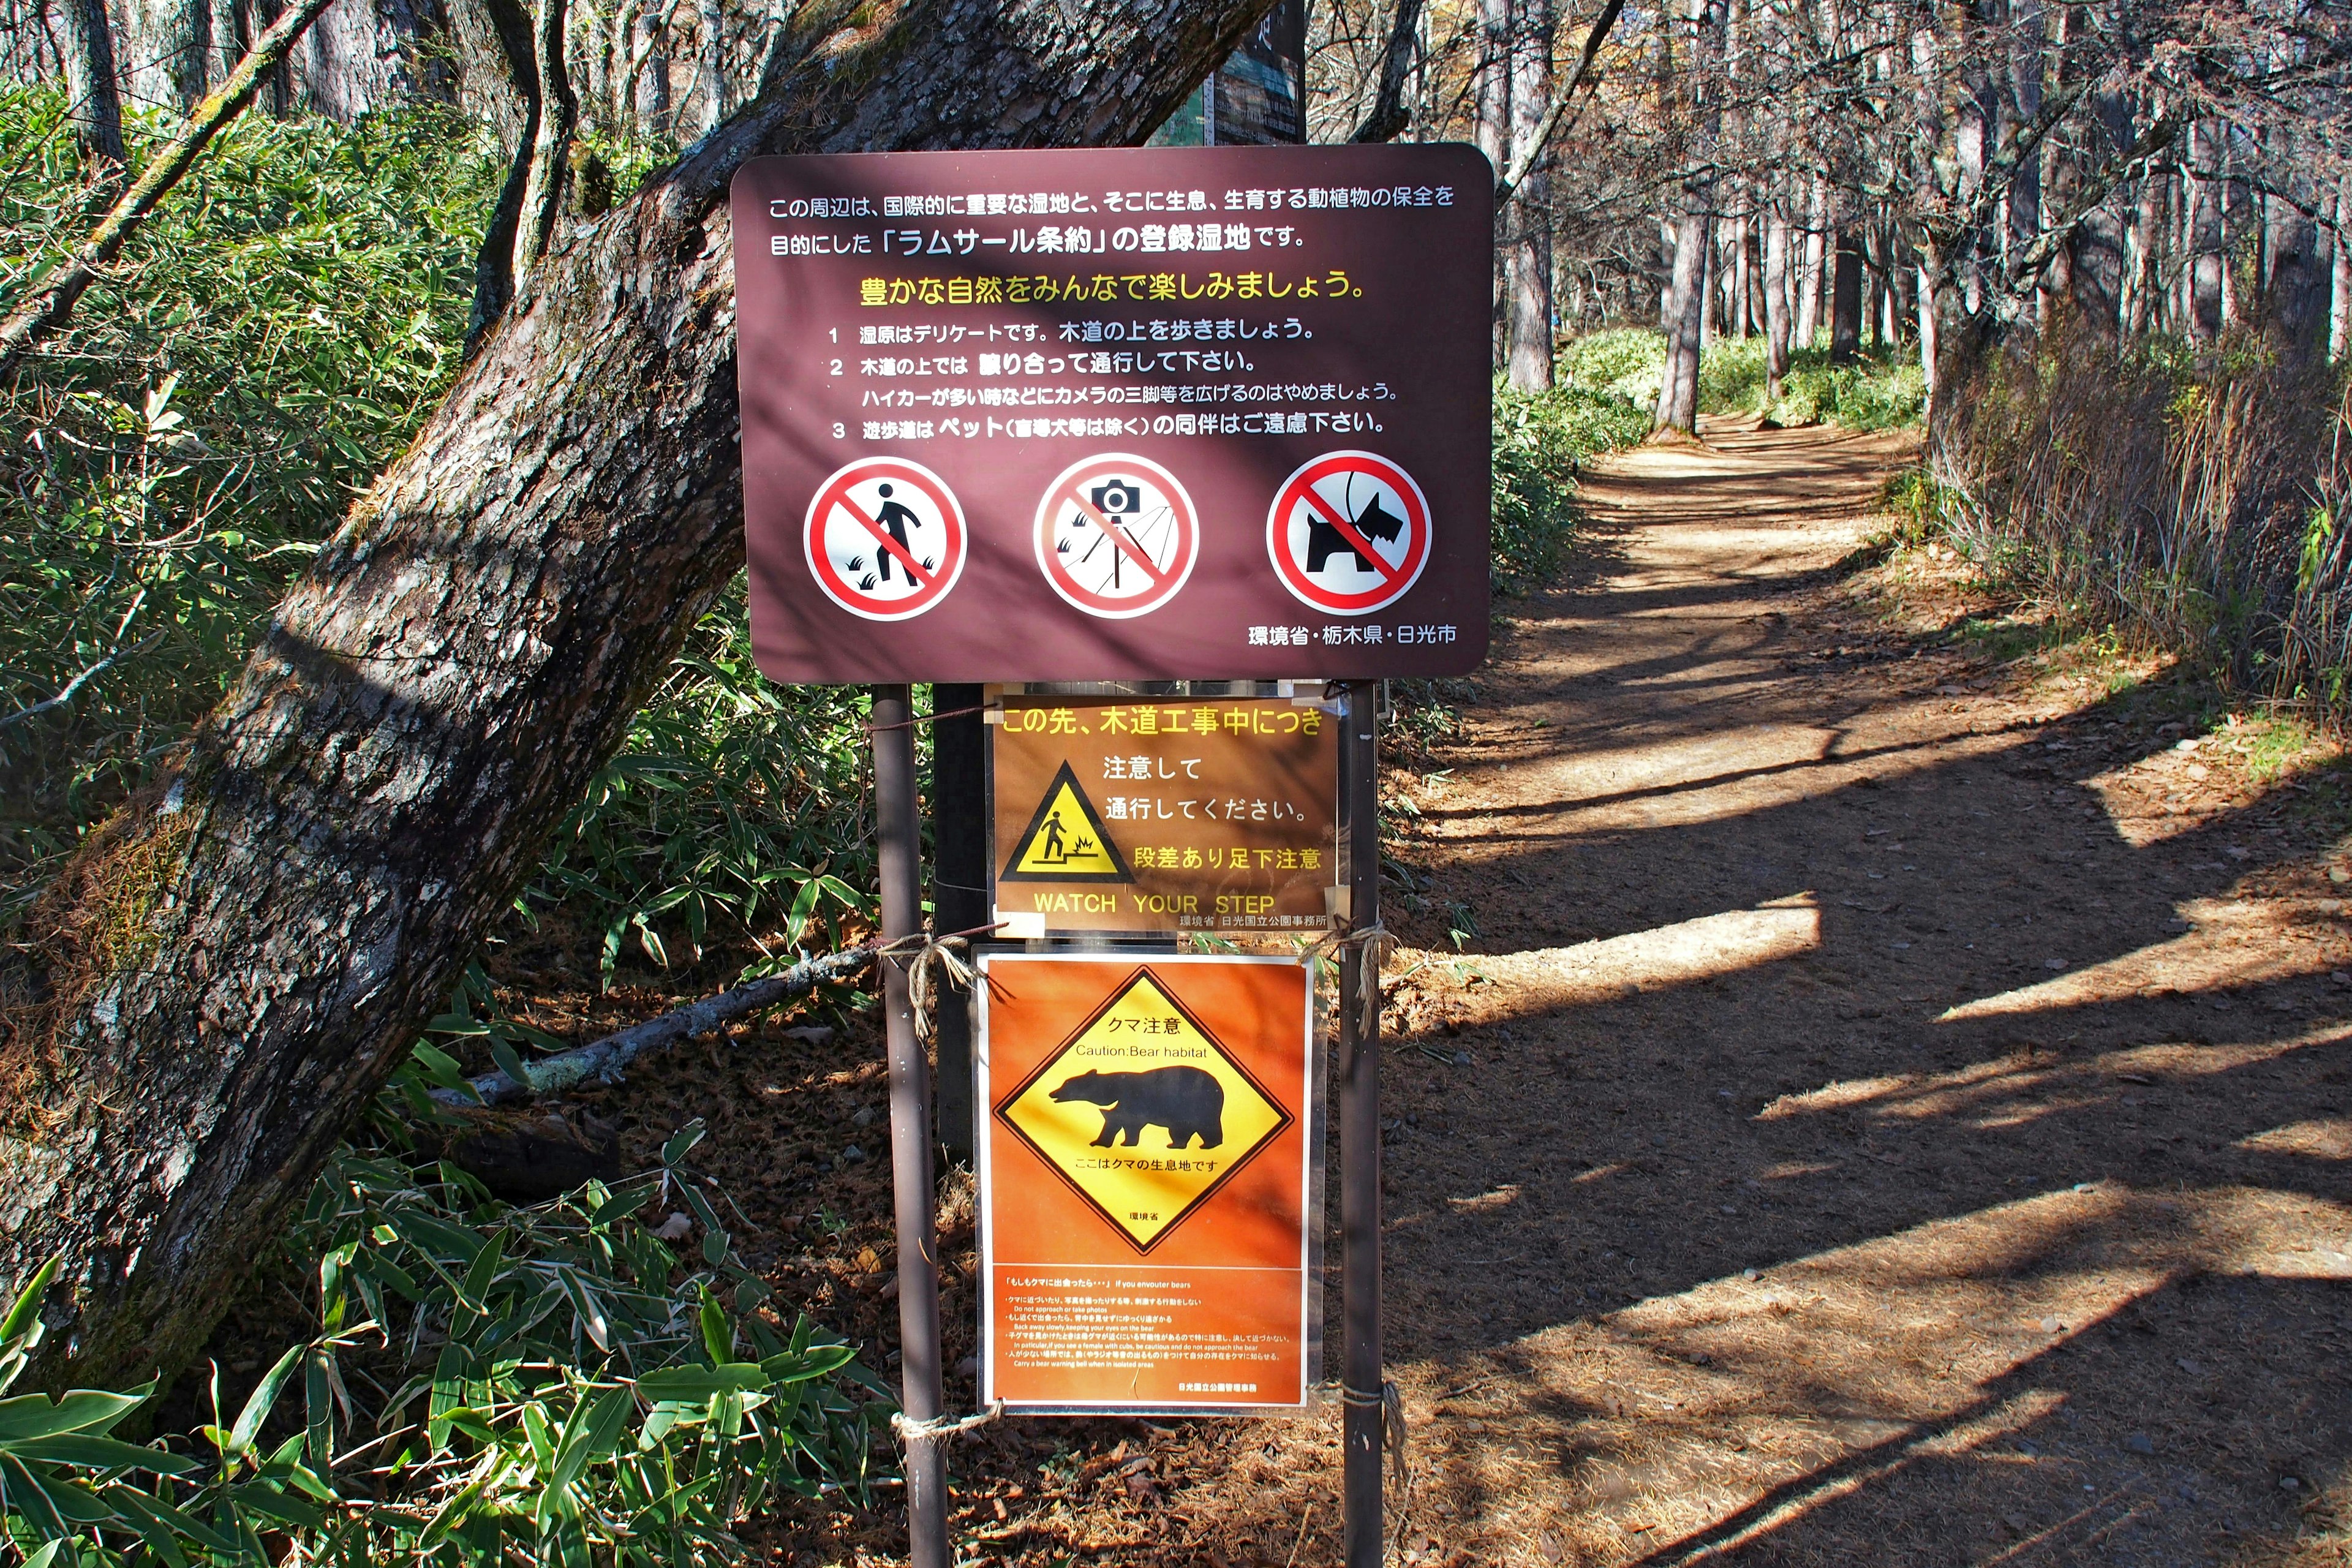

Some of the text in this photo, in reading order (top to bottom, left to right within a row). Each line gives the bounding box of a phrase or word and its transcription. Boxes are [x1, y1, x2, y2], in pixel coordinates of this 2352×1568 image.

[769, 186, 1454, 218] この周辺は、国際的に重要な湿地と、そこに生息、生育する動植物の保全を
[771, 222, 1304, 256] 目的にした「ラムサール条約」の登録湿地です。
[860, 270, 1363, 306] 豊かな自然をみんなで楽しみましょう。
[829, 326, 838, 344] 1
[829, 358, 843, 376] 2
[862, 383, 1397, 407] ハイカーが多い時などにカメラの三脚等を広げるのはやめましょう。
[832, 423, 845, 439] 3
[1248, 624, 1458, 646] 環境省・栃木県・日光市
[1003, 705, 1322, 736] この先、木道工事中につき
[1103, 755, 1202, 780] 注意して
[1106, 797, 1305, 821] 通行してください。
[1134, 847, 1321, 869] 段差あり足下注意
[1035, 893, 1274, 914] WATCH YOUR STEP
[1180, 915, 1327, 927] 環境省 日光国立公園事務所
[1109, 1017, 1182, 1035] クマ注意
[1164, 1046, 1207, 1058] habitat
[1076, 1158, 1218, 1172] ここはクマの生息地です
[1129, 1212, 1159, 1221] 環境省
